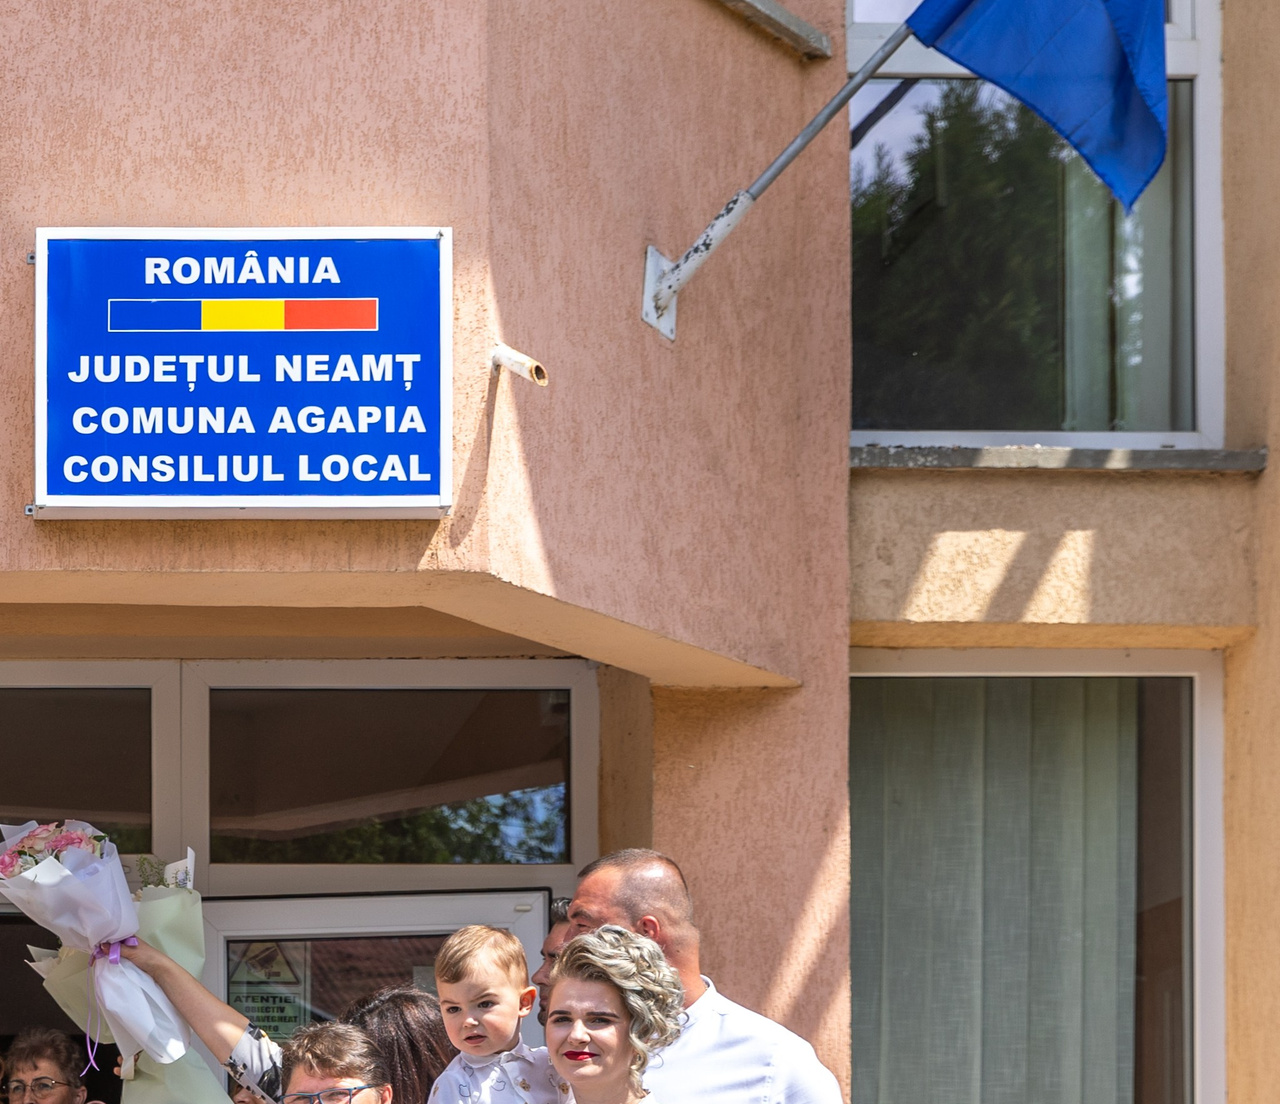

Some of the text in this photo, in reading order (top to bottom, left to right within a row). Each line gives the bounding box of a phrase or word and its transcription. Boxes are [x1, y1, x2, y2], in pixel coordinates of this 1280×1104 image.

[144, 250, 341, 285] ROMÂNIA
[67, 354, 421, 392] JUDEȚUL NEAMȚ
[72, 405, 427, 435] COMUNA AGAPIA
[63, 454, 431, 483] CONSILIUL LOCAL
